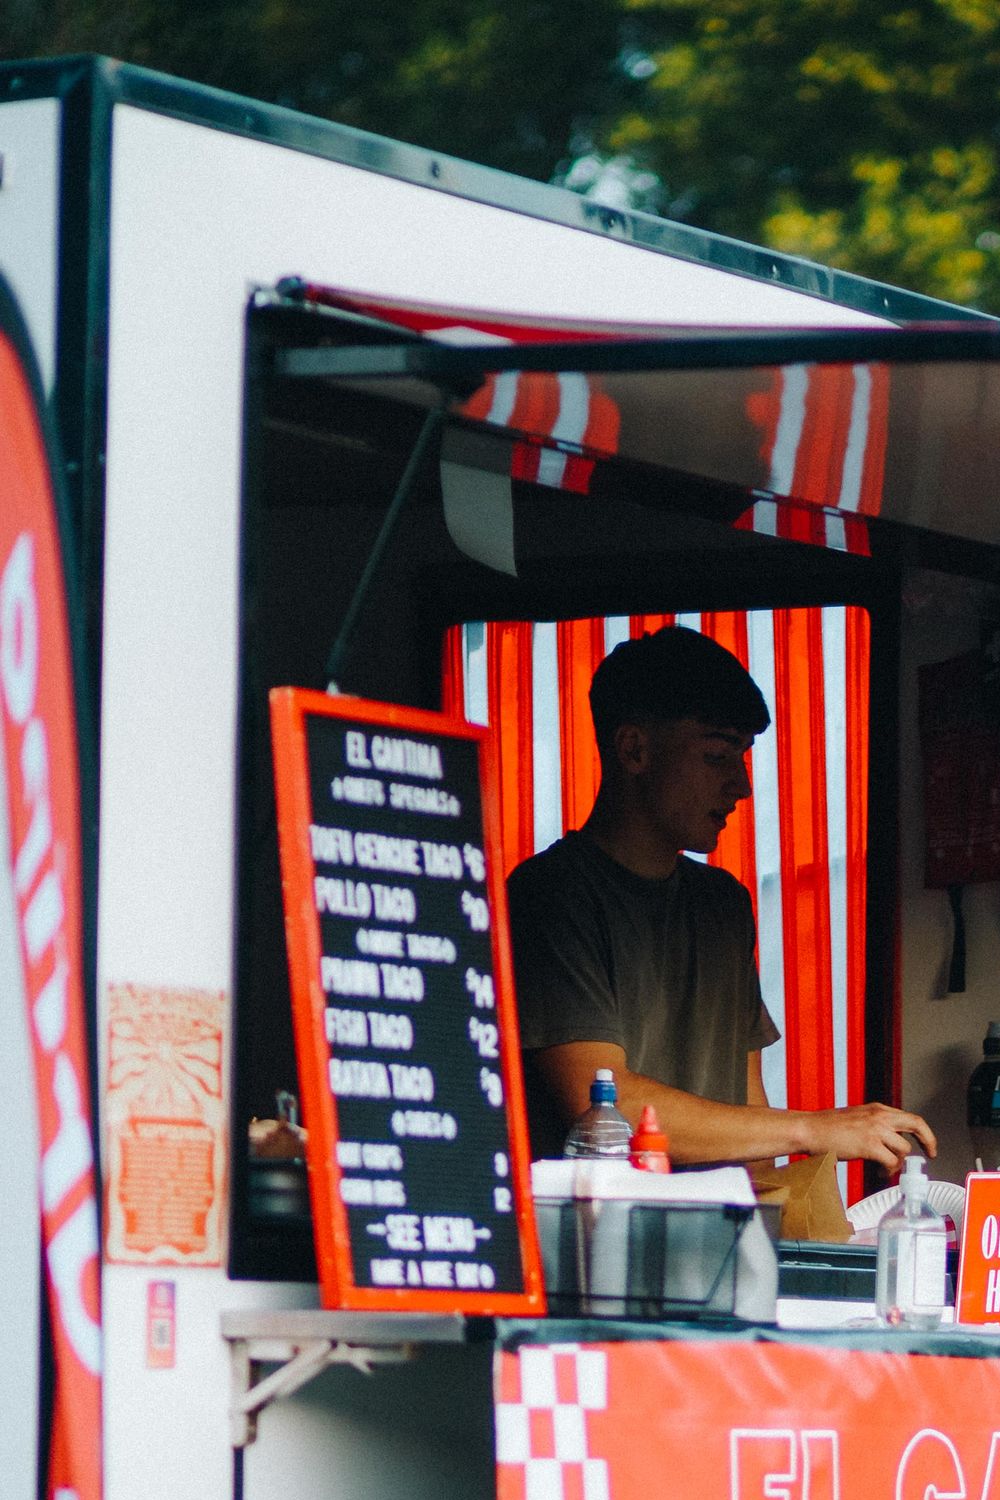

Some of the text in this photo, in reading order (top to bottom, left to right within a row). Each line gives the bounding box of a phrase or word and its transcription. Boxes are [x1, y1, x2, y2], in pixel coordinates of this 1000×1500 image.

[346, 731, 443, 780] EL CANTINA
[309, 824, 354, 866] TOFU
[420, 841, 463, 881] TACO
[314, 876, 372, 918] POLLO
[371, 883, 417, 924] TACO
[380, 963, 425, 1003] TACO
[325, 1007, 499, 1059] FISH TACO $12
[388, 1063, 435, 1103] TACO
